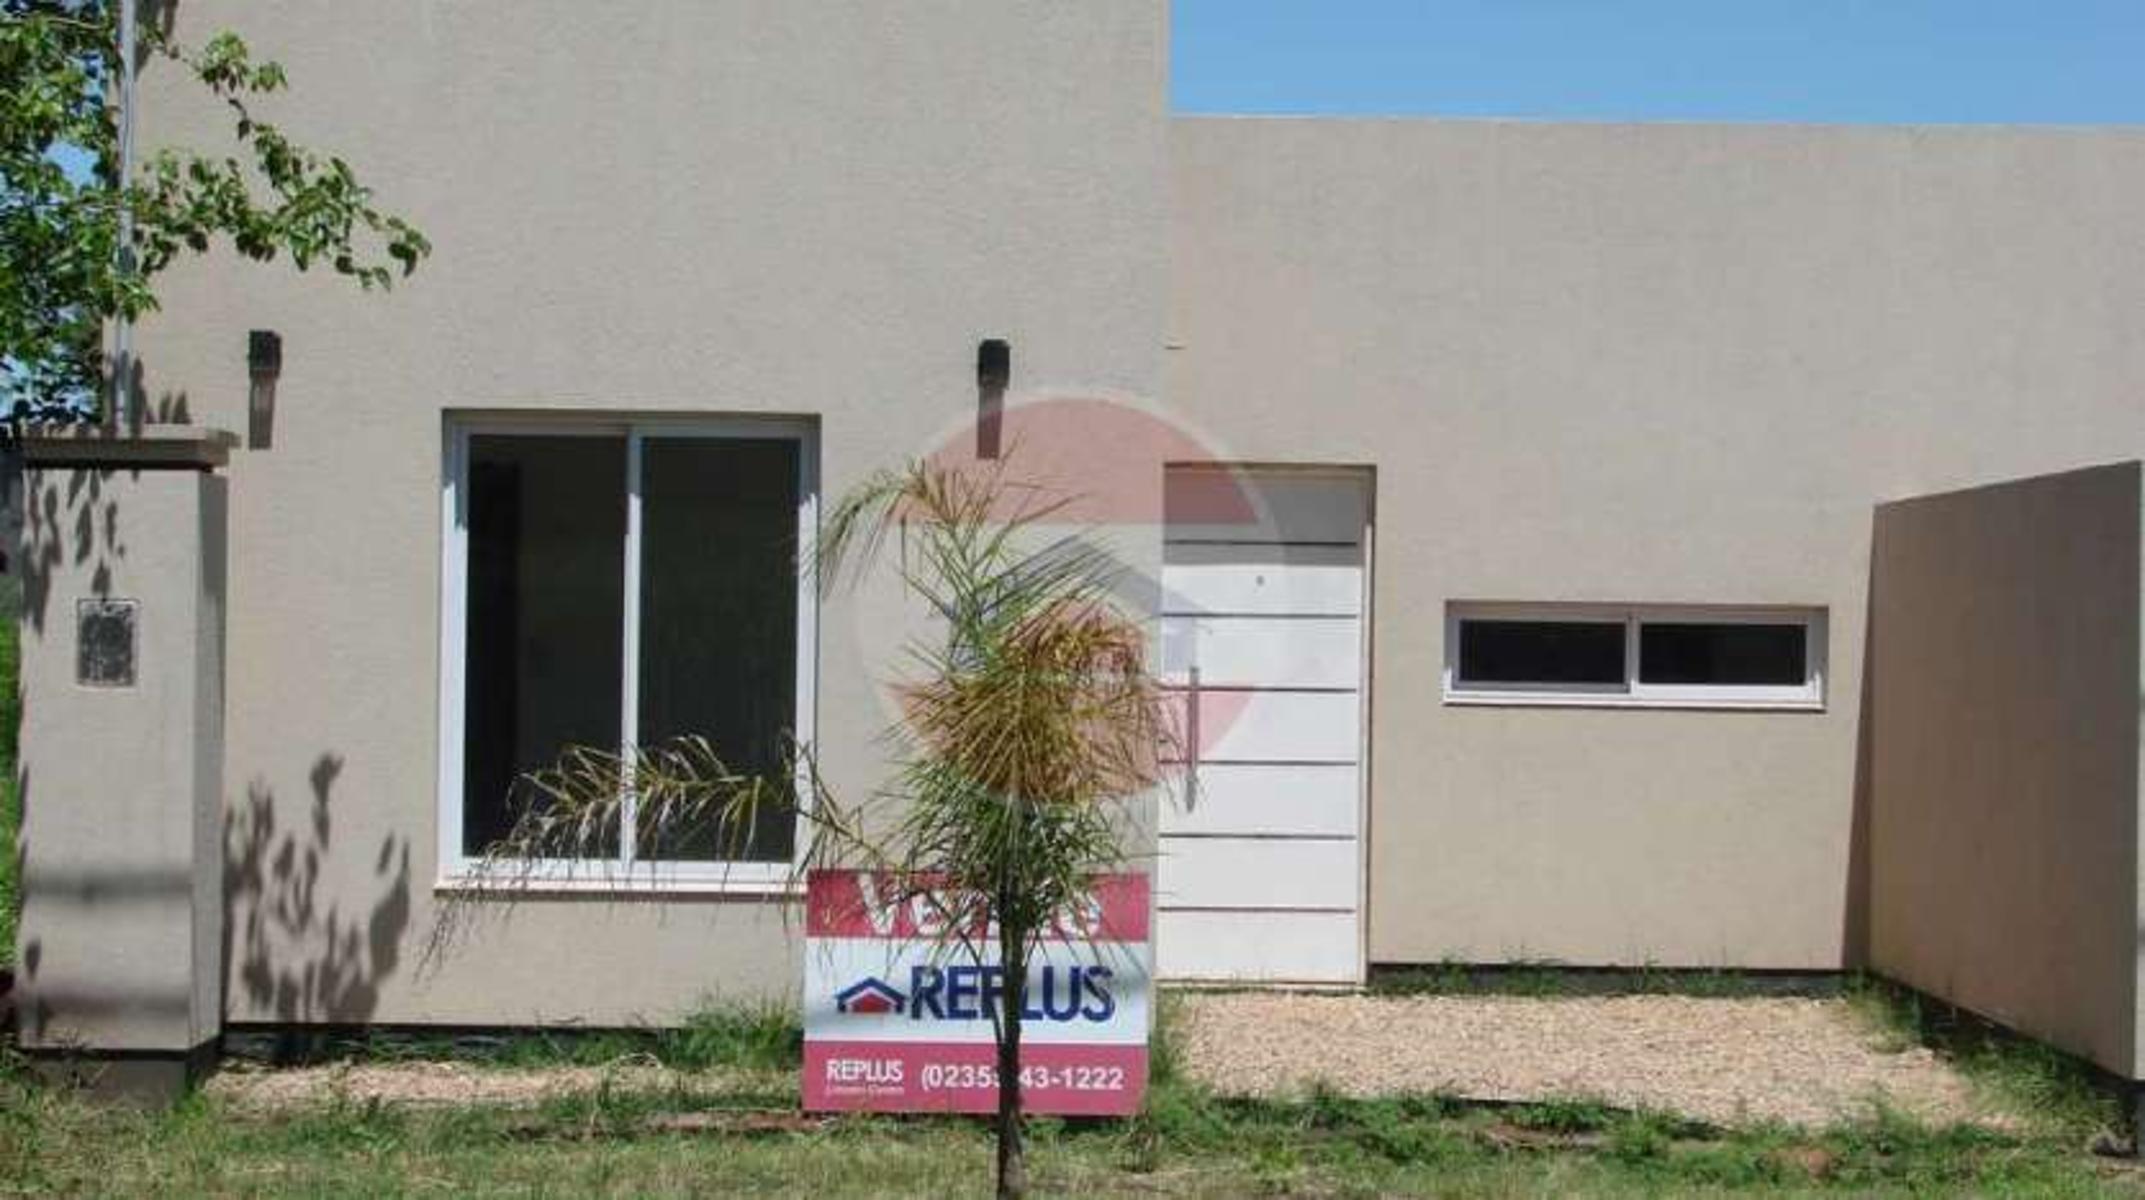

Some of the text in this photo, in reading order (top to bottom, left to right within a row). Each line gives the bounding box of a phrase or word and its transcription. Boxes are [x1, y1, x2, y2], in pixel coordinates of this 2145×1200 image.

[857, 874, 1102, 936] Veo
[826, 1058, 904, 1082] REPLUS
[921, 1064, 1003, 1091] (0235
[1018, 1065, 1124, 1090] 43-1222
